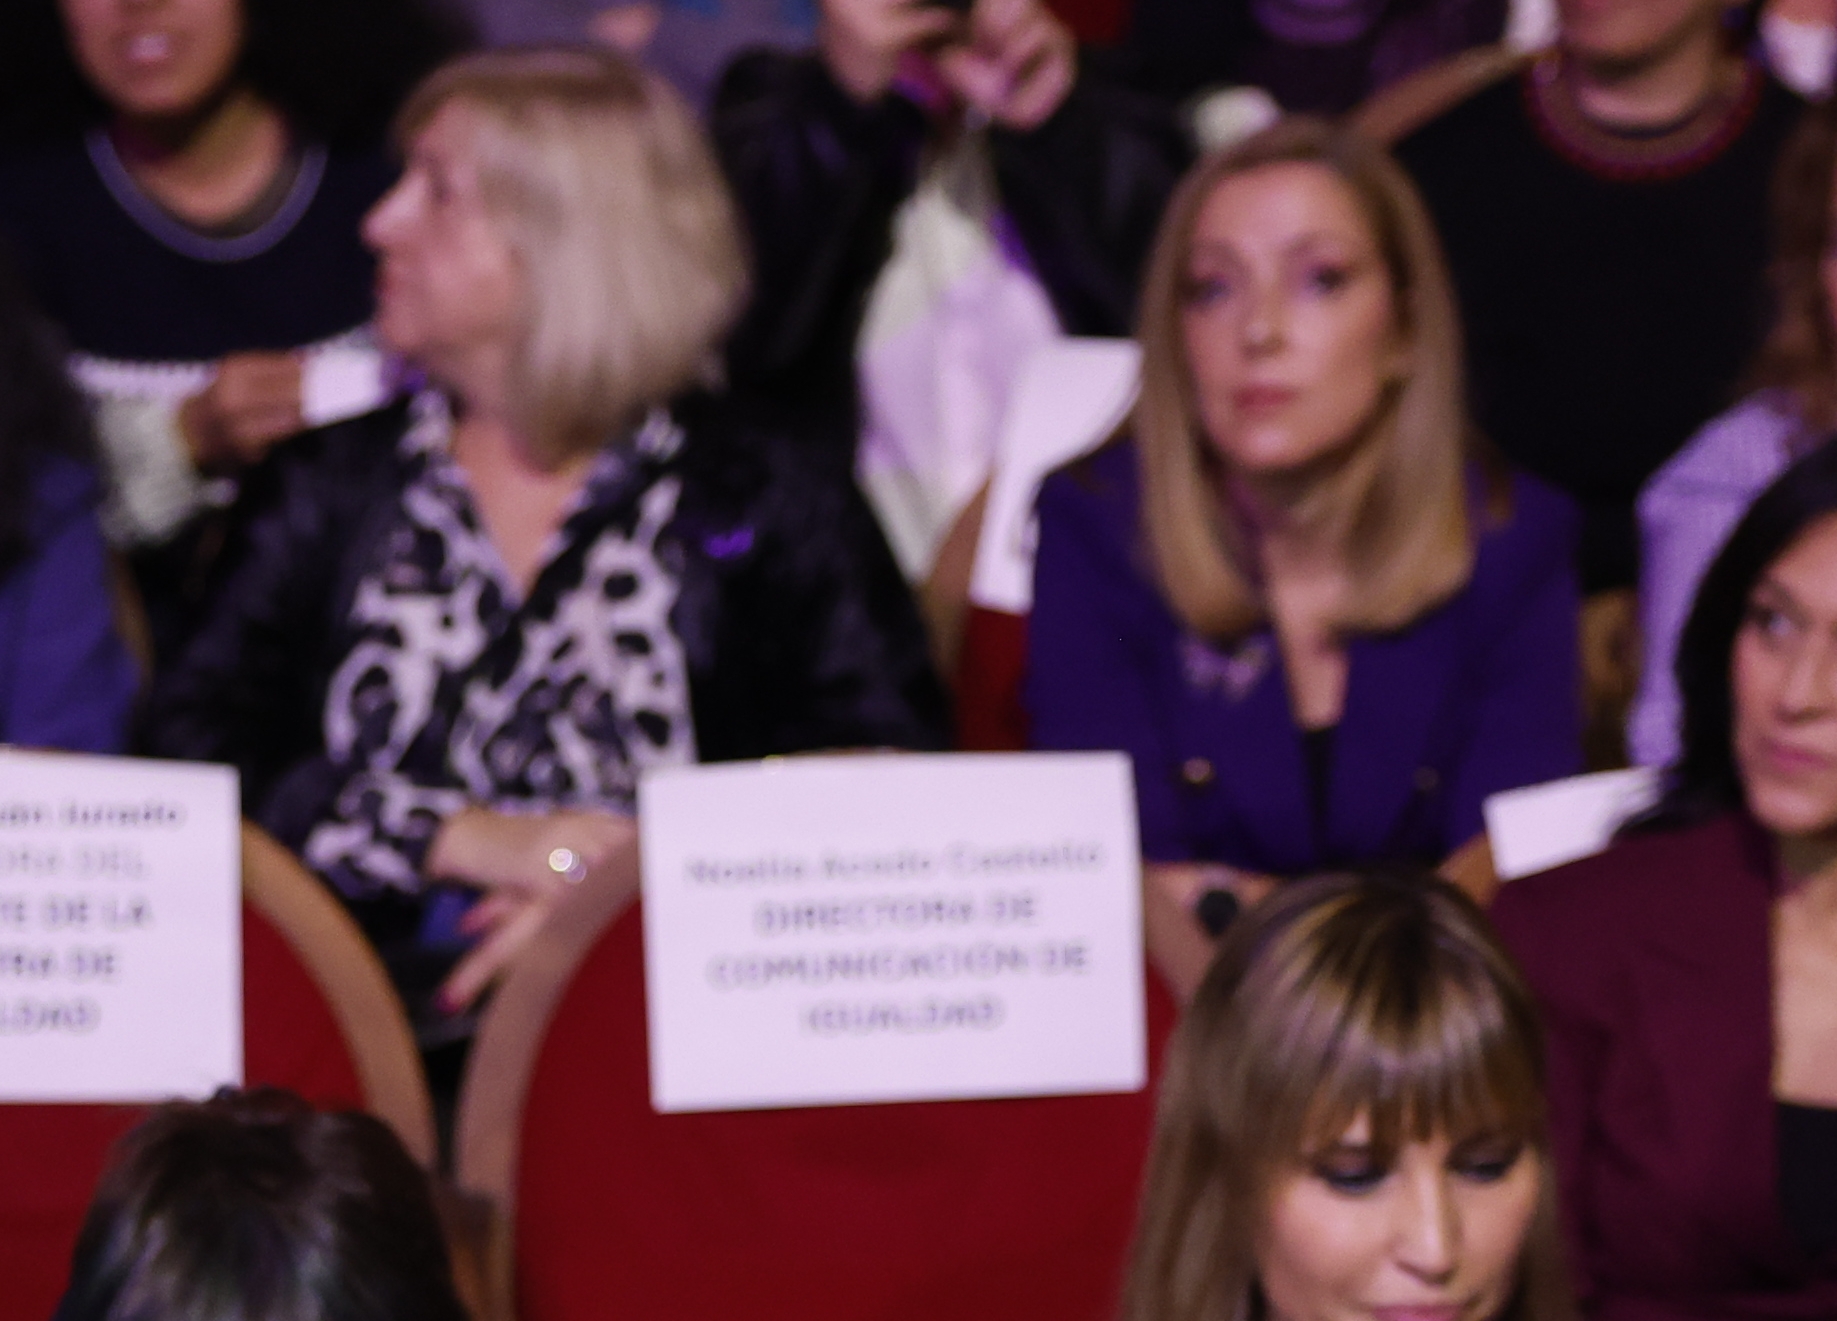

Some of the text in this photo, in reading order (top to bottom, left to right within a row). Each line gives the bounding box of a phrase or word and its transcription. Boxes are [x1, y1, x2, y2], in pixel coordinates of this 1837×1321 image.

[41, 894, 95, 930] DE
[103, 894, 151, 930] LA
[755, 889, 1042, 937] DIRECTORA DE
[67, 946, 123, 982] DE
[1039, 938, 1094, 976] DE
[800, 992, 1003, 1038] IGUALDAD
